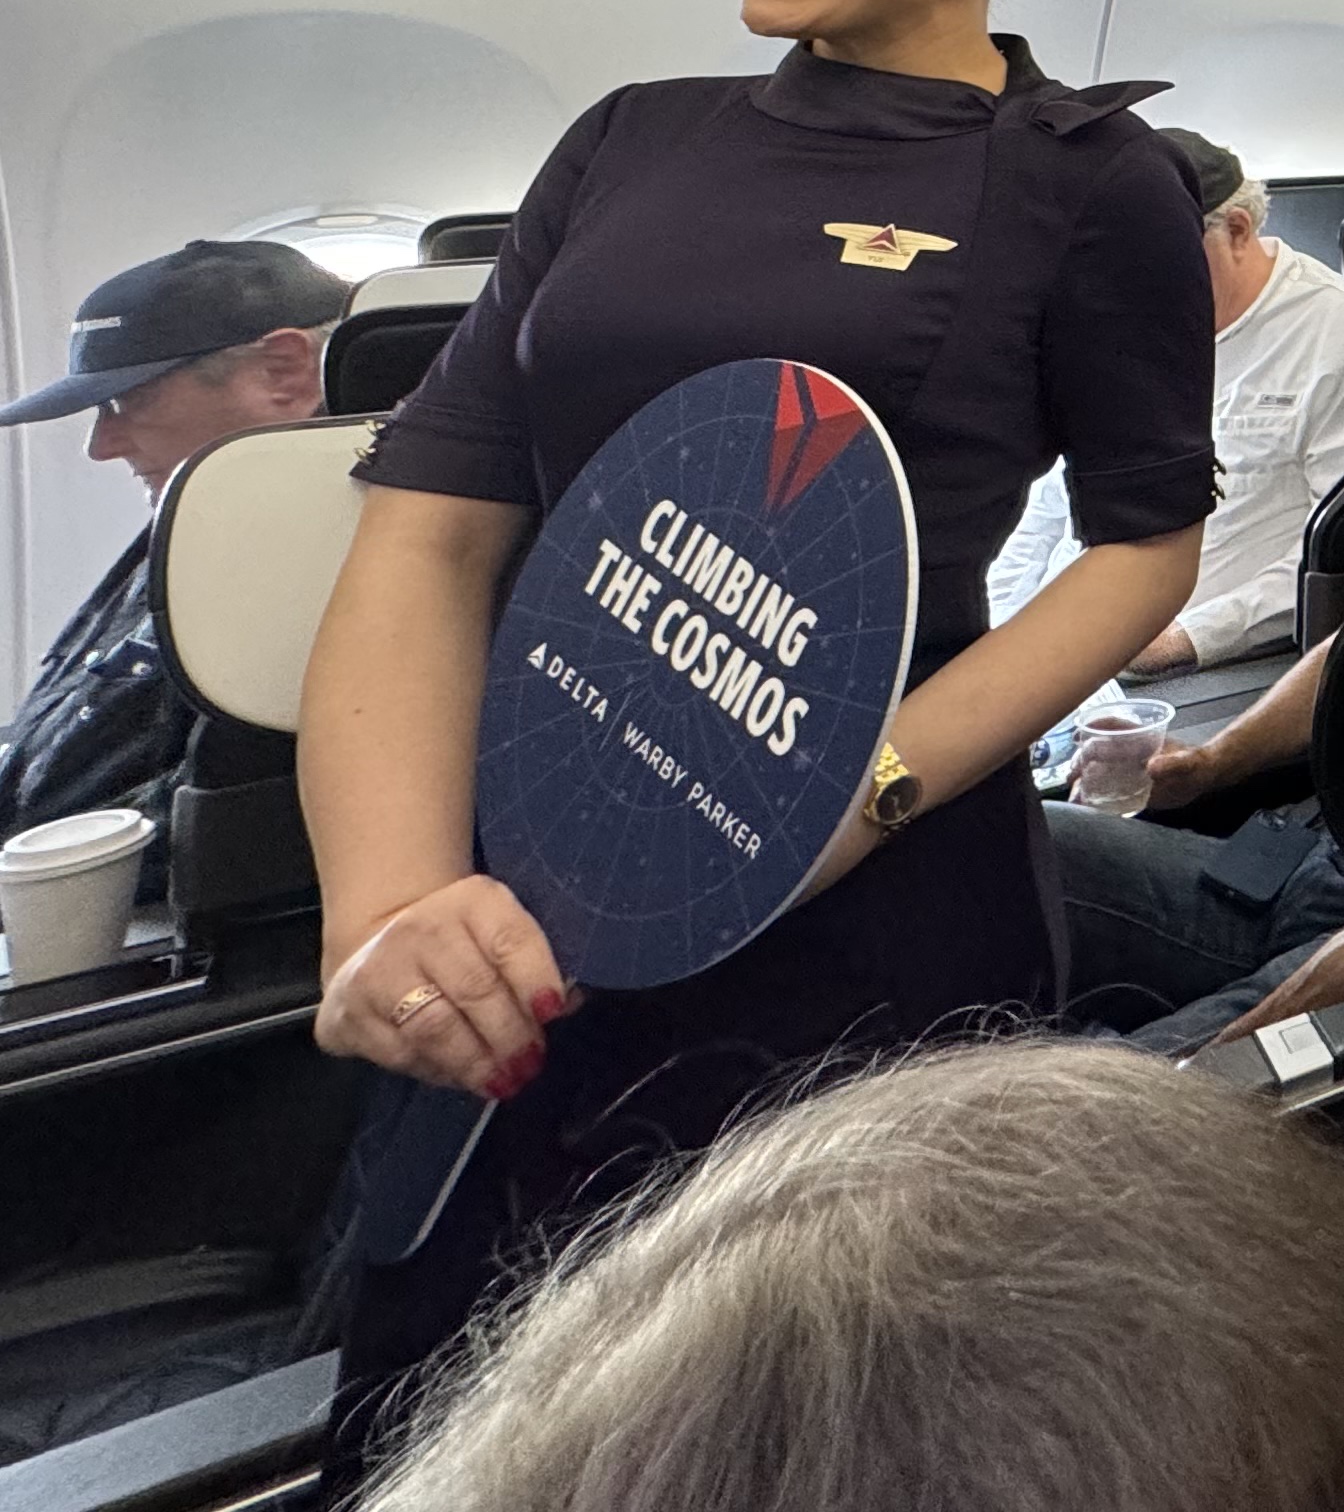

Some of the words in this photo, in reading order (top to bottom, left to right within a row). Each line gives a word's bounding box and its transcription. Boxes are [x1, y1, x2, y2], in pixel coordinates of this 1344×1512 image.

[584, 538, 663, 635] THE
[651, 598, 810, 757] COSMOS
[640, 499, 819, 668] CLIMBING
[546, 654, 609, 723] DELTA
[622, 721, 689, 788] WARBY
[686, 781, 762, 860] PARKER
